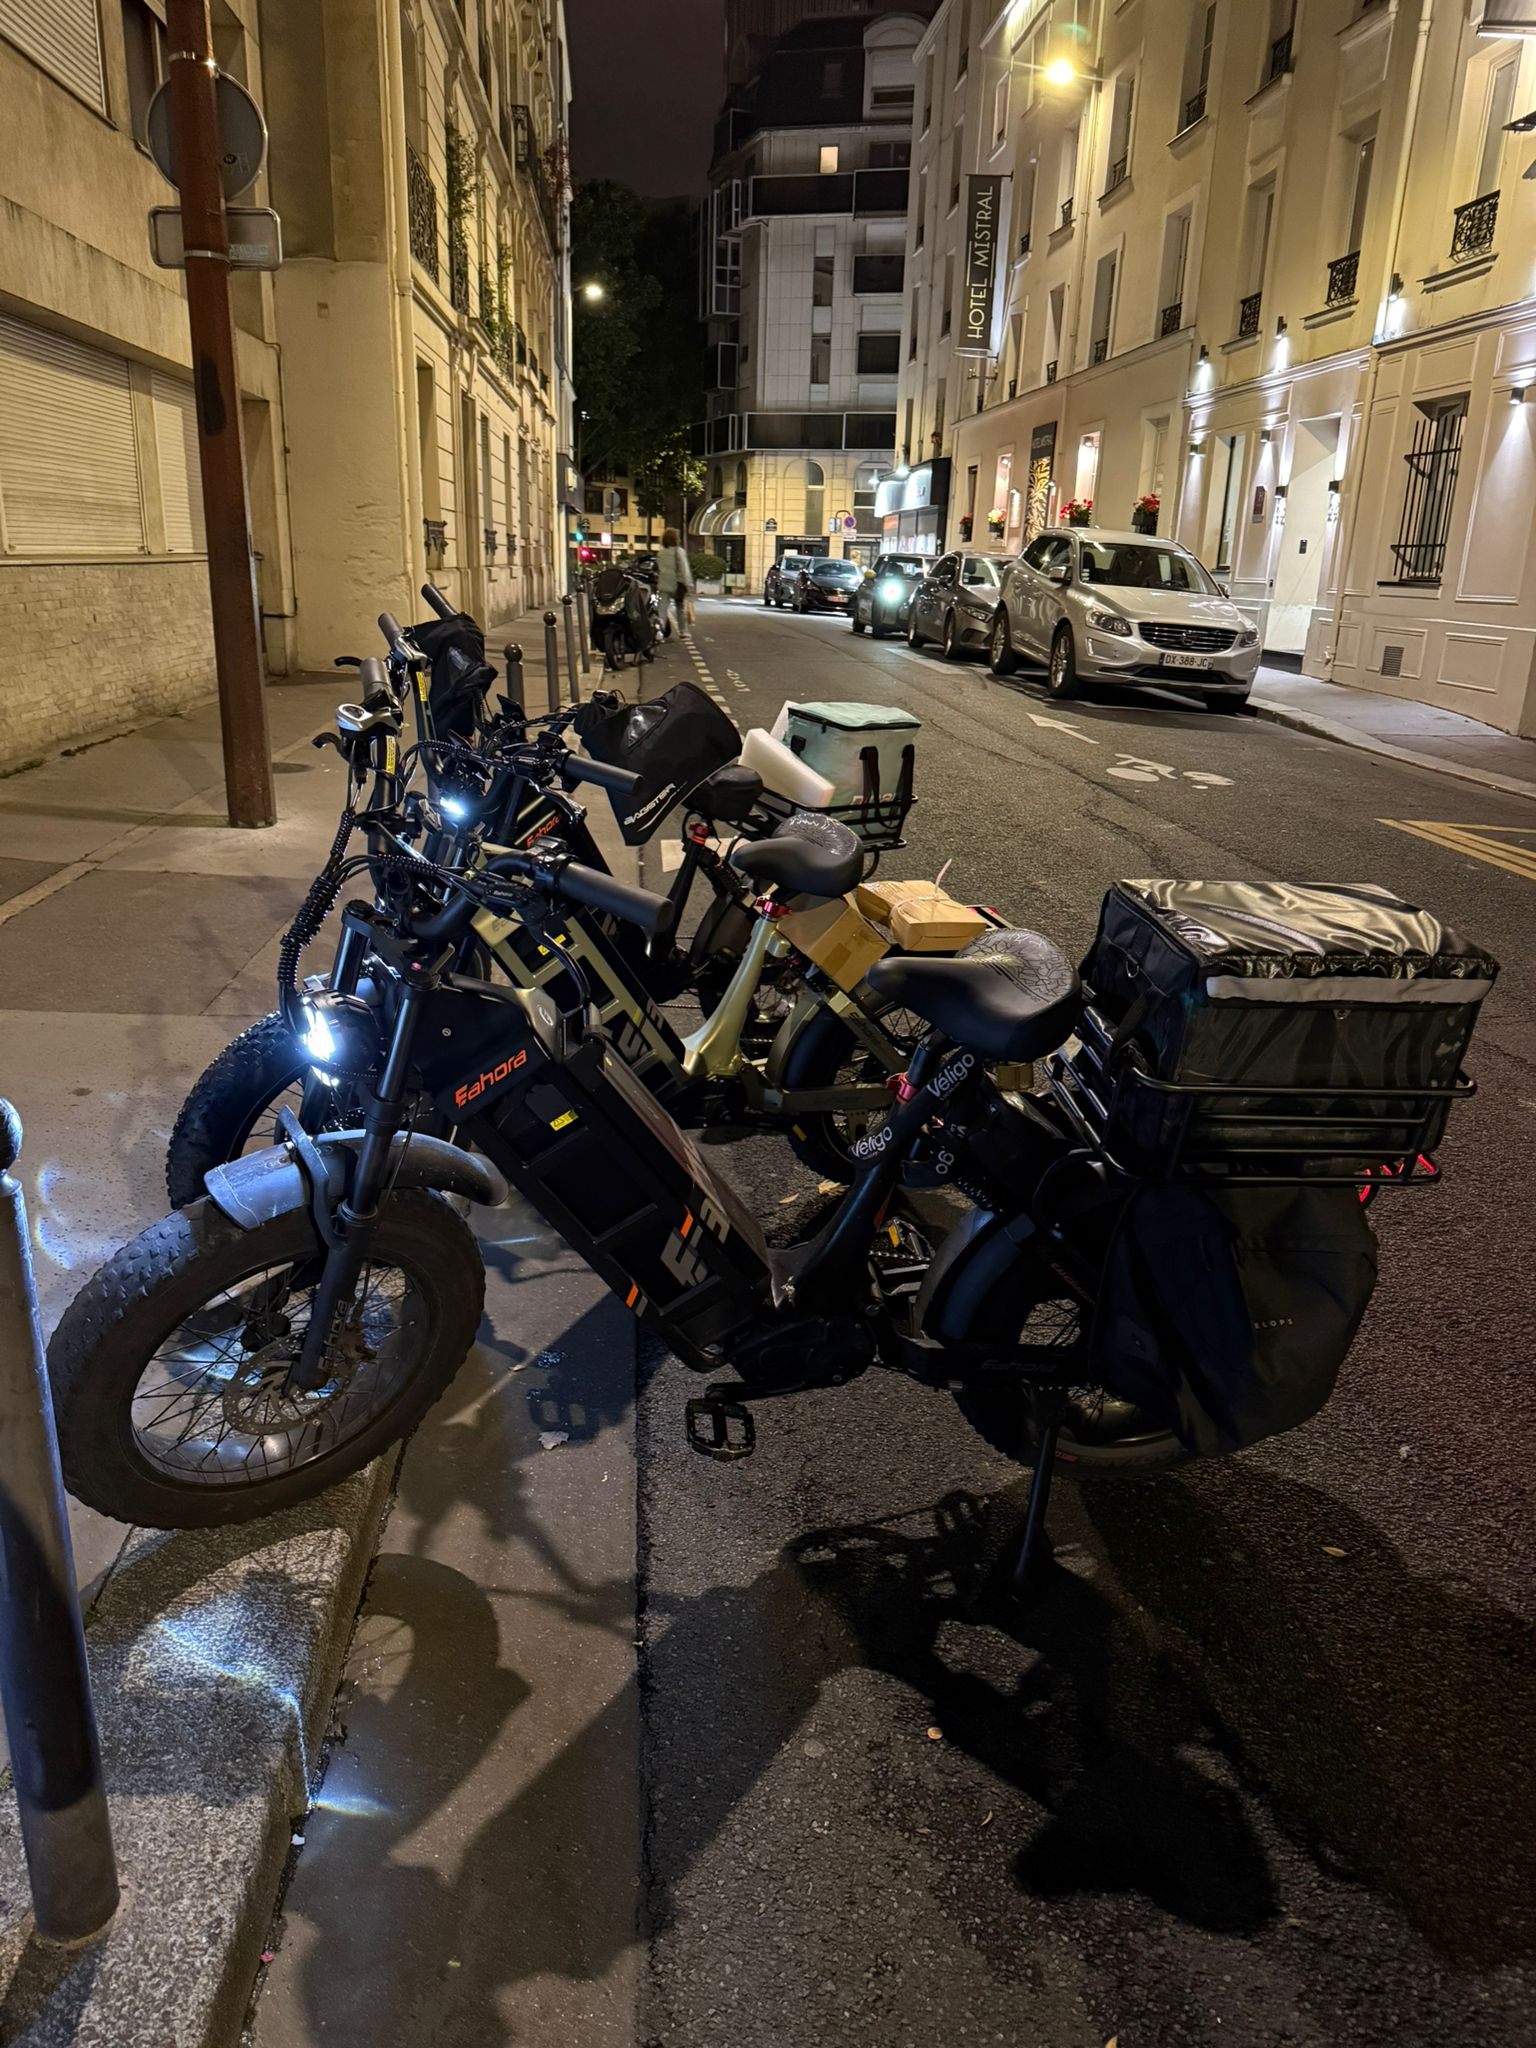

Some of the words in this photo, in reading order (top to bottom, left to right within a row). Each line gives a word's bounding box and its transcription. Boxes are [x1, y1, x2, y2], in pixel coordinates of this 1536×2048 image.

[974, 186, 994, 267] MISTRAL
[967, 278, 988, 339] HOTEL
[1165, 655, 1208, 667] DX-388-JC
[623, 783, 677, 826] BAGSTER
[454, 1049, 528, 1110] Eahora
[926, 1052, 975, 1098] Véligo
[851, 1126, 893, 1157] Véligo
[1253, 1318, 1295, 1329] ELOPS
